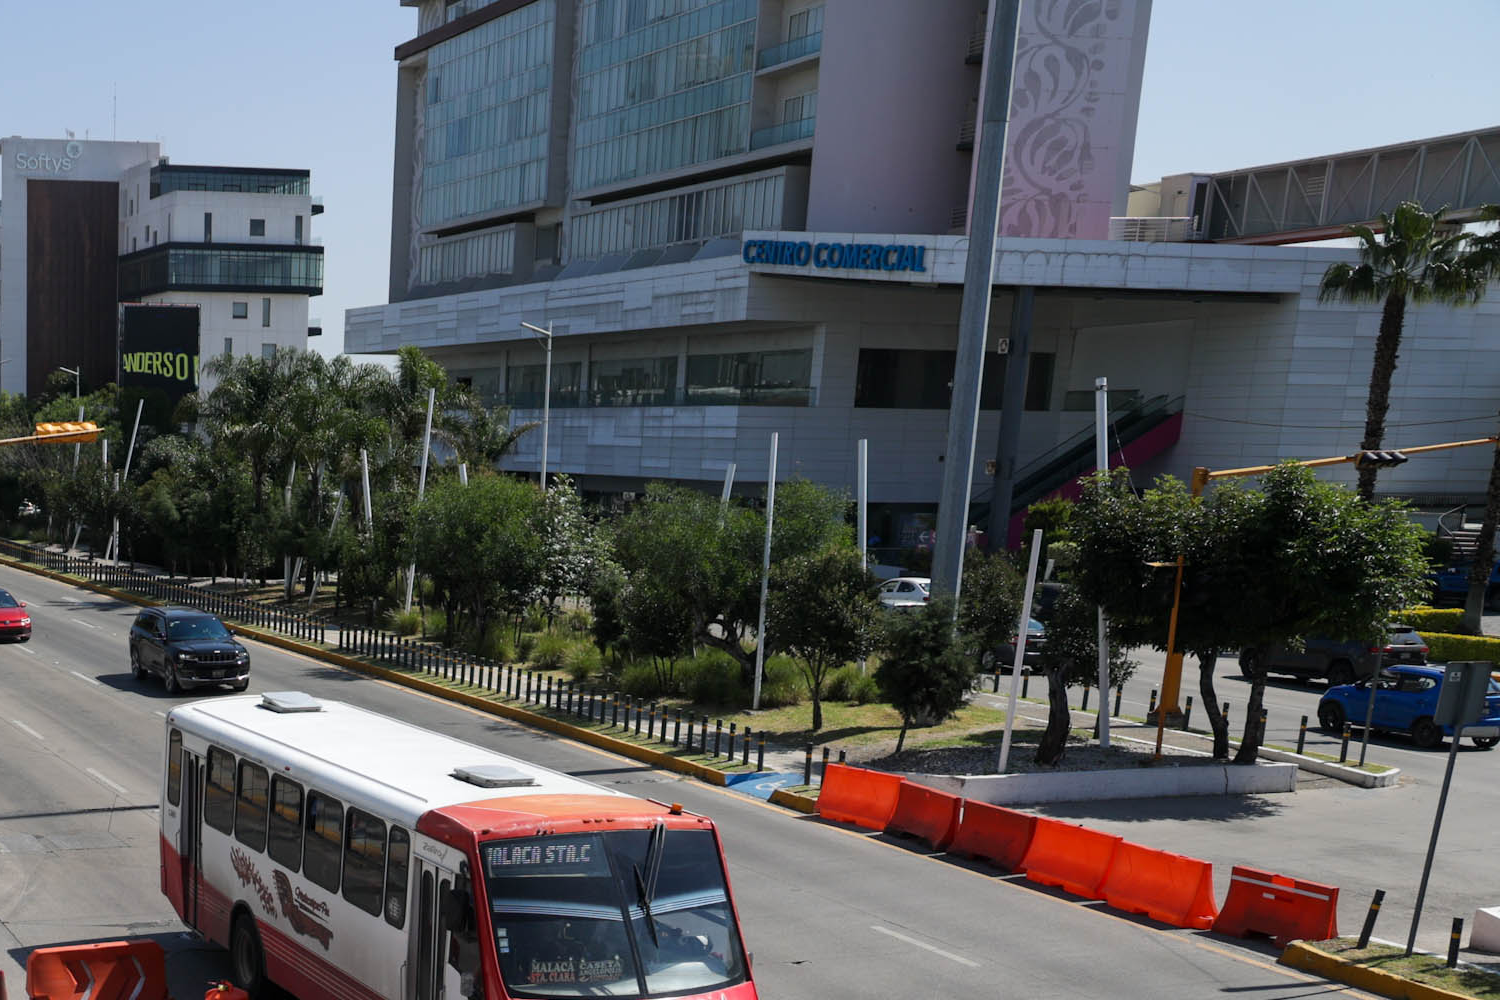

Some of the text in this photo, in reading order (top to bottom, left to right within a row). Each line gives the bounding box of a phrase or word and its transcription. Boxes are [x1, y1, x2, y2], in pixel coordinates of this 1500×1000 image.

[16, 152, 71, 174] Softys
[742, 239, 927, 273] CENTRO COMERCIAL
